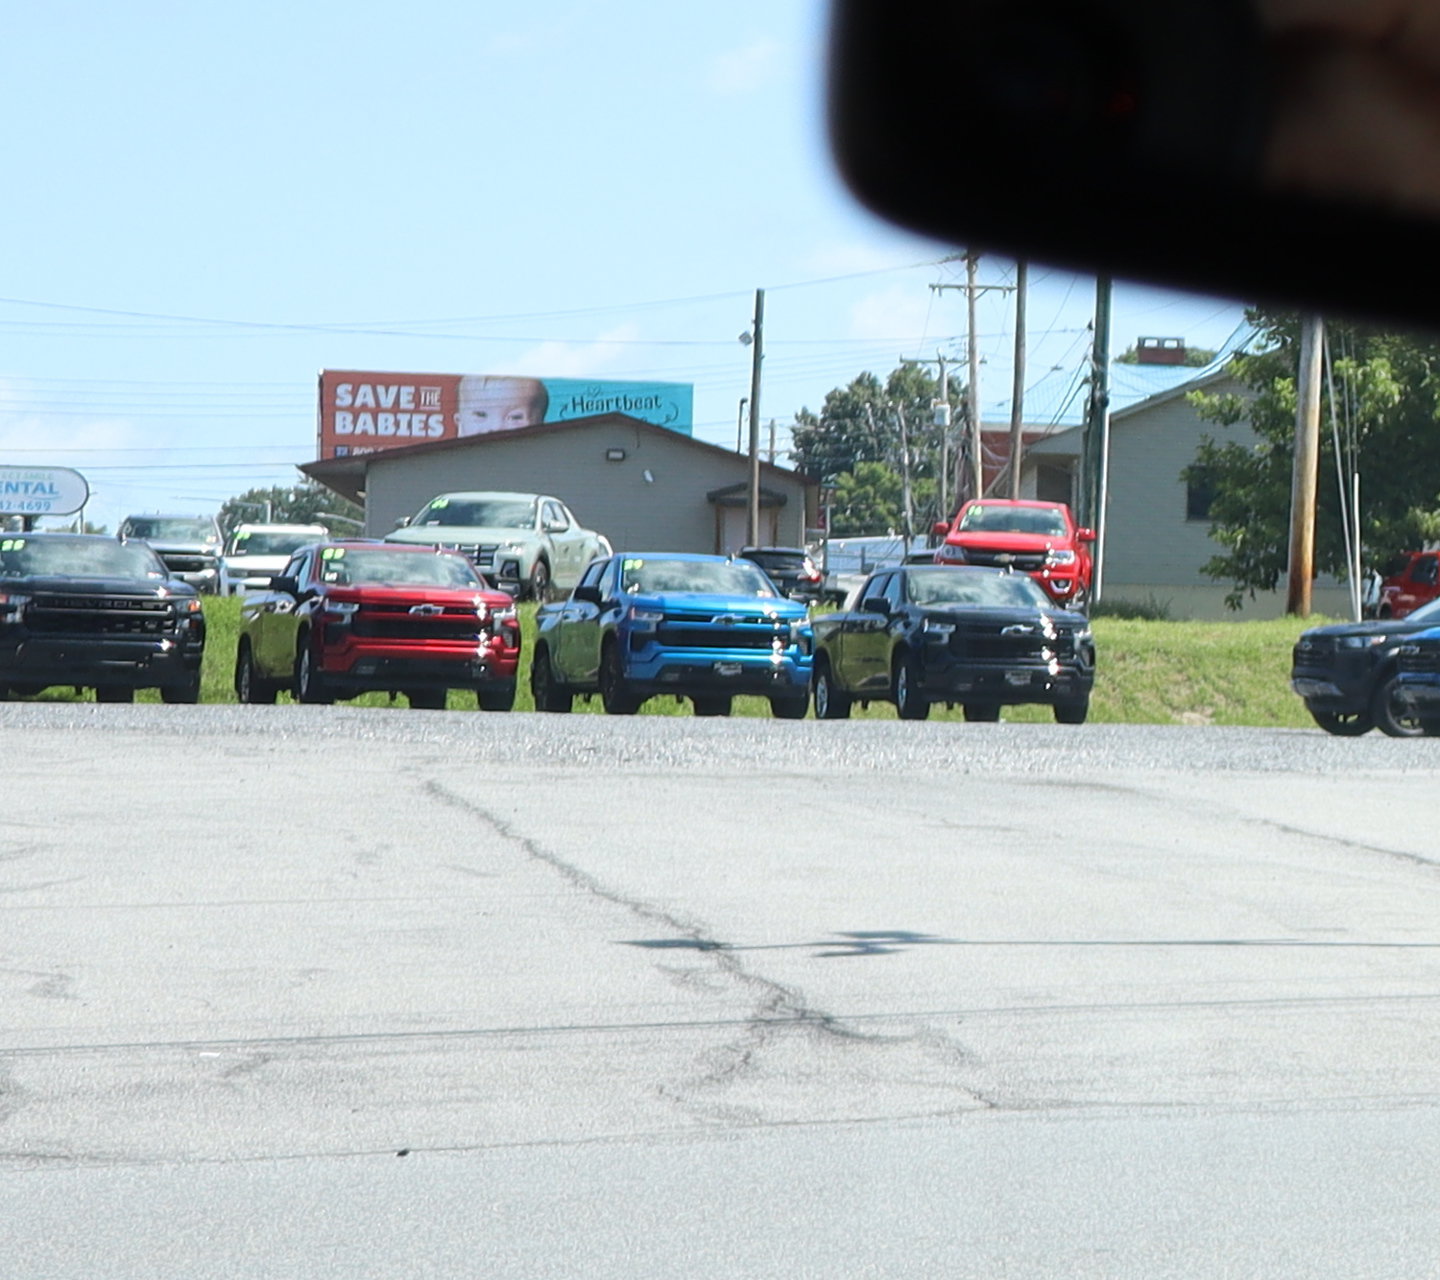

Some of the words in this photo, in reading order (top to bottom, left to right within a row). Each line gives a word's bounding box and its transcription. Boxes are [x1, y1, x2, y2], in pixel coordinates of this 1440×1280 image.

[335, 383, 415, 408] SAVE
[420, 391, 441, 407] THE
[571, 394, 662, 413] Heartbeat
[335, 411, 445, 437] BABIES
